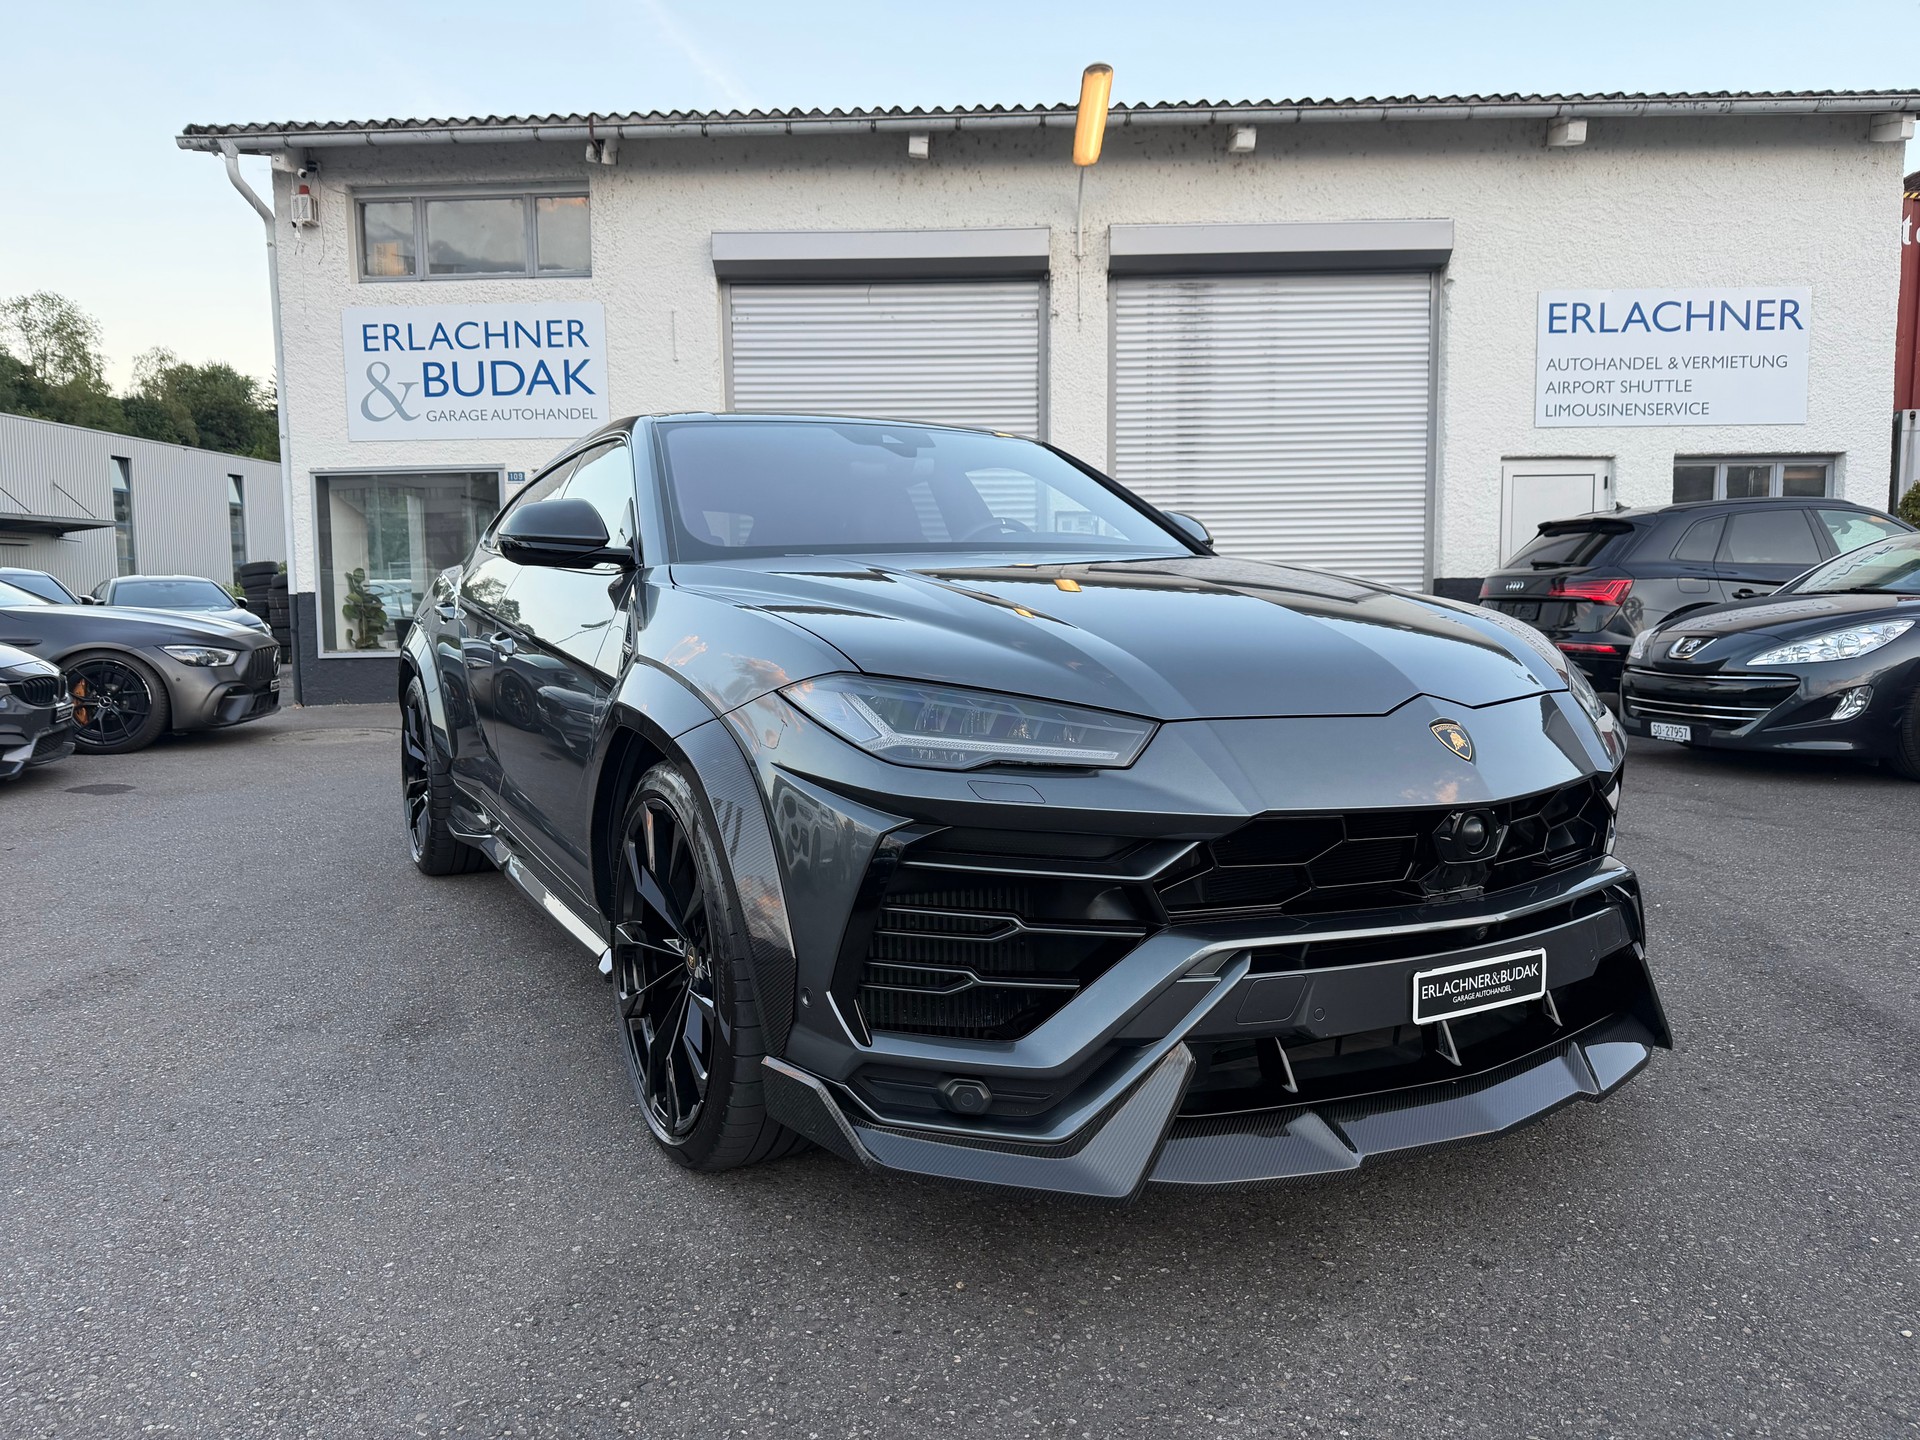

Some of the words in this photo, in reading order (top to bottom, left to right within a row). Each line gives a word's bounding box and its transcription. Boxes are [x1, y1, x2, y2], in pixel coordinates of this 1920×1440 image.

[1548, 299, 1804, 334] ERLACHNER
[362, 319, 590, 352] ERLACHNER
[1546, 356, 1663, 372] AUTOHANDEL
[1667, 356, 1679, 370] &
[1681, 354, 1788, 370] VERMIETUNG
[360, 361, 421, 422] &
[422, 359, 596, 398] BUDAK
[1545, 380, 1615, 394] AIRPORT
[1620, 379, 1693, 393] SHUTTLE
[426, 408, 488, 422] GARAGE
[491, 407, 598, 421] AUTOHANDEL
[1545, 402, 1710, 418] LIMOUSINENSERVICE
[510, 472, 523, 480] 109
[1452, 991, 1476, 1003] GARAGE
[1475, 984, 1512, 998] AUTOHANDEL
